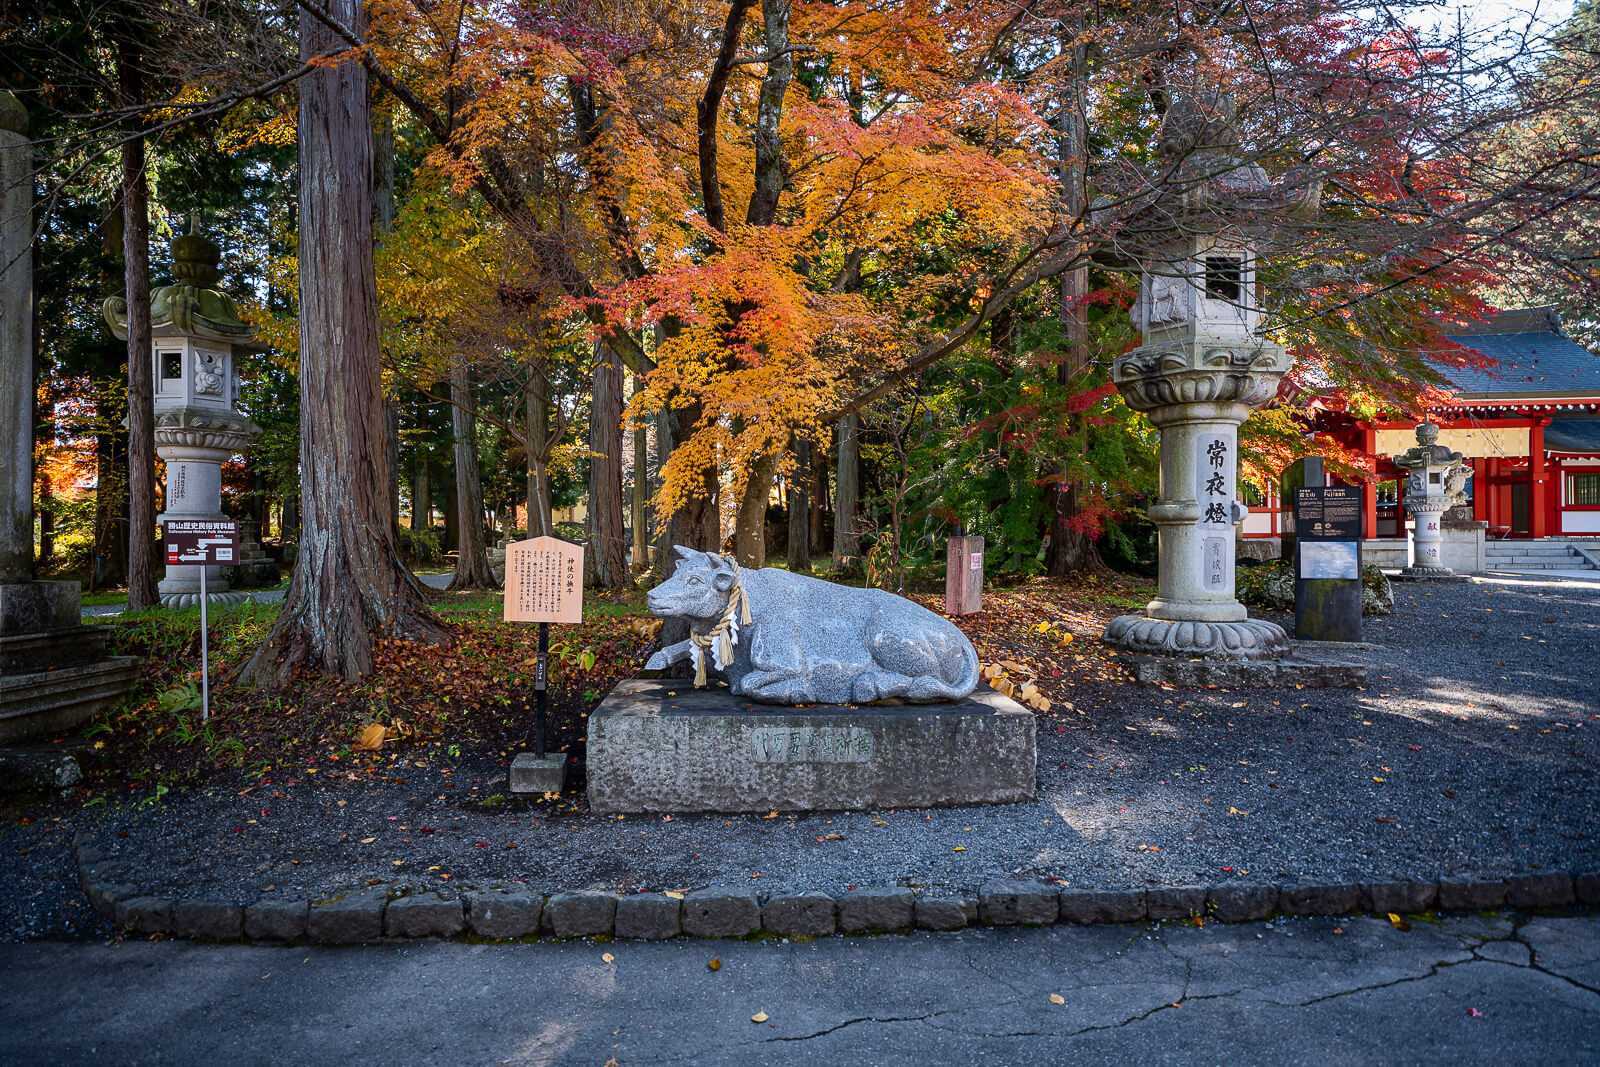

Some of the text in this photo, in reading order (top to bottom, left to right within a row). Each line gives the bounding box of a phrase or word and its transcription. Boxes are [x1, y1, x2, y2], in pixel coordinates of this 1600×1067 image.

[1203, 439, 1228, 524] 常夜燈
[566, 557, 575, 595] 神使の撫牛
